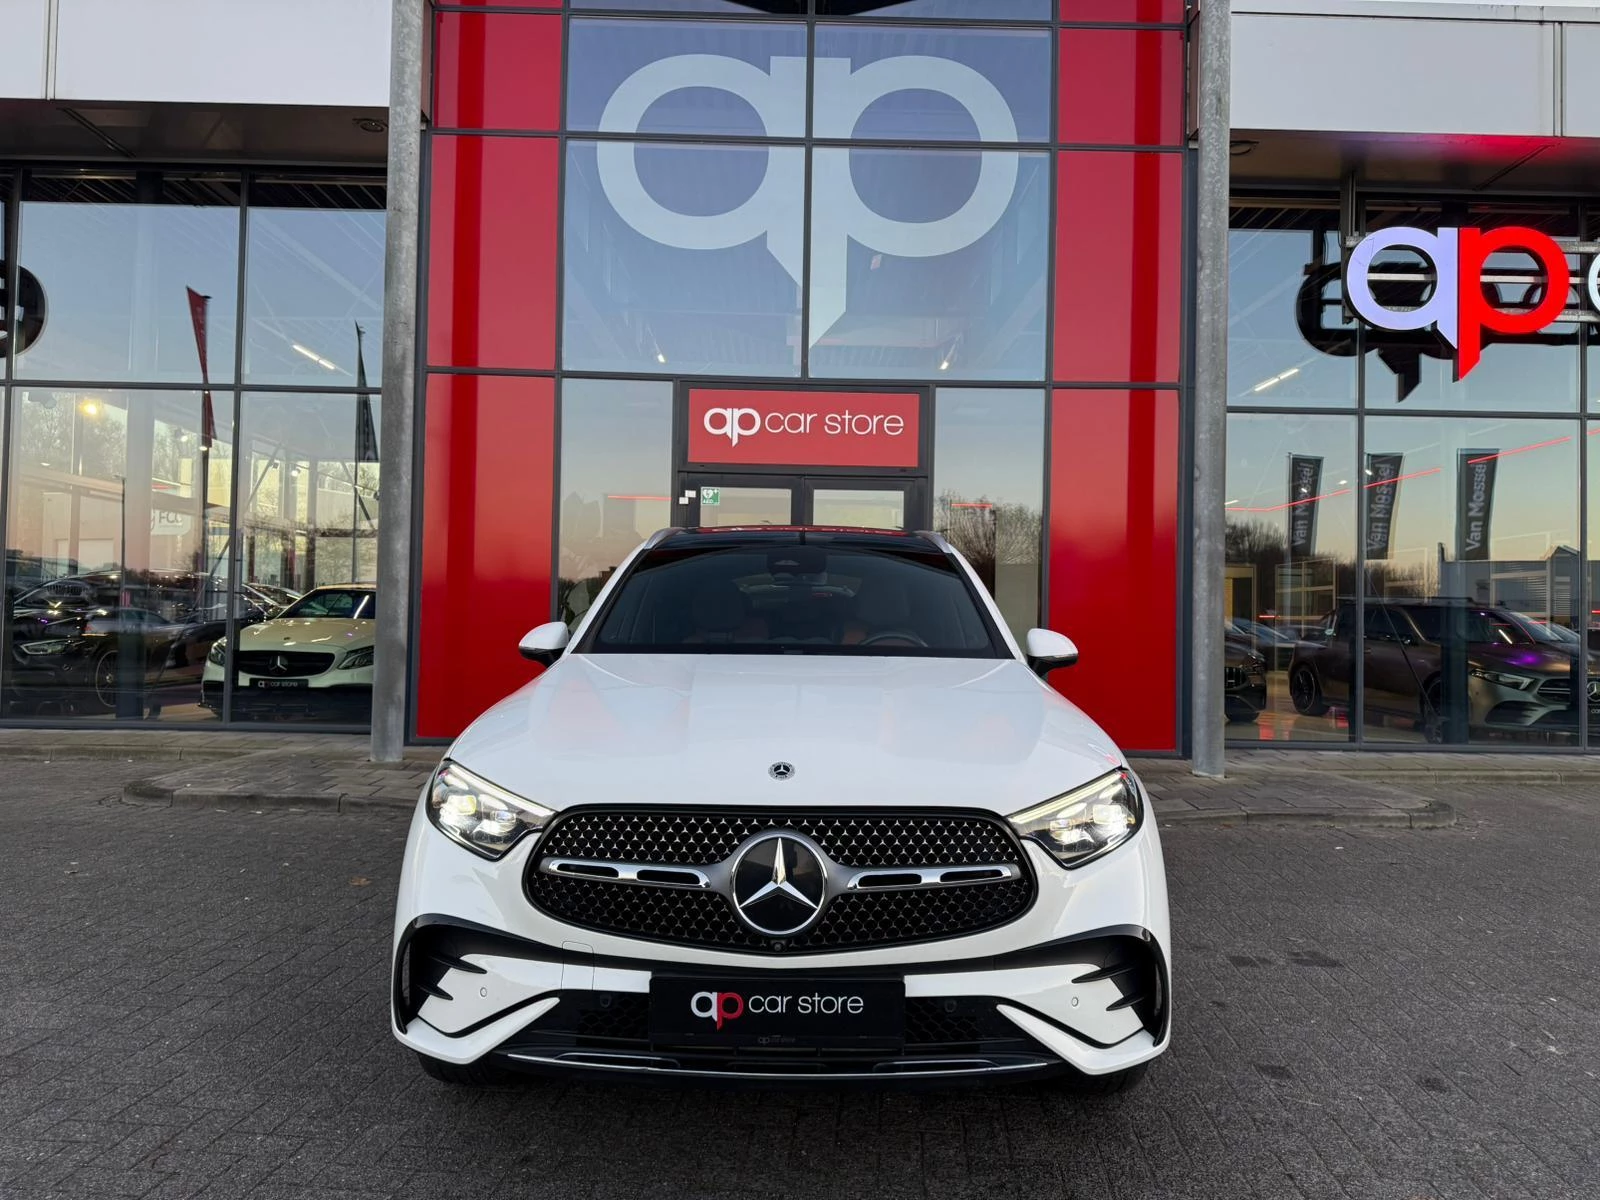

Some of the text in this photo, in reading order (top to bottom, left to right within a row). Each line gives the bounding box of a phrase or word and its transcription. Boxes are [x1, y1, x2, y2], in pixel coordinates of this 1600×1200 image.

[597, 54, 1018, 348] ap
[1347, 226, 1570, 380] ap
[703, 407, 904, 447] ap car store
[1465, 521, 1483, 551] Van
[690, 991, 864, 1030] ap car store
